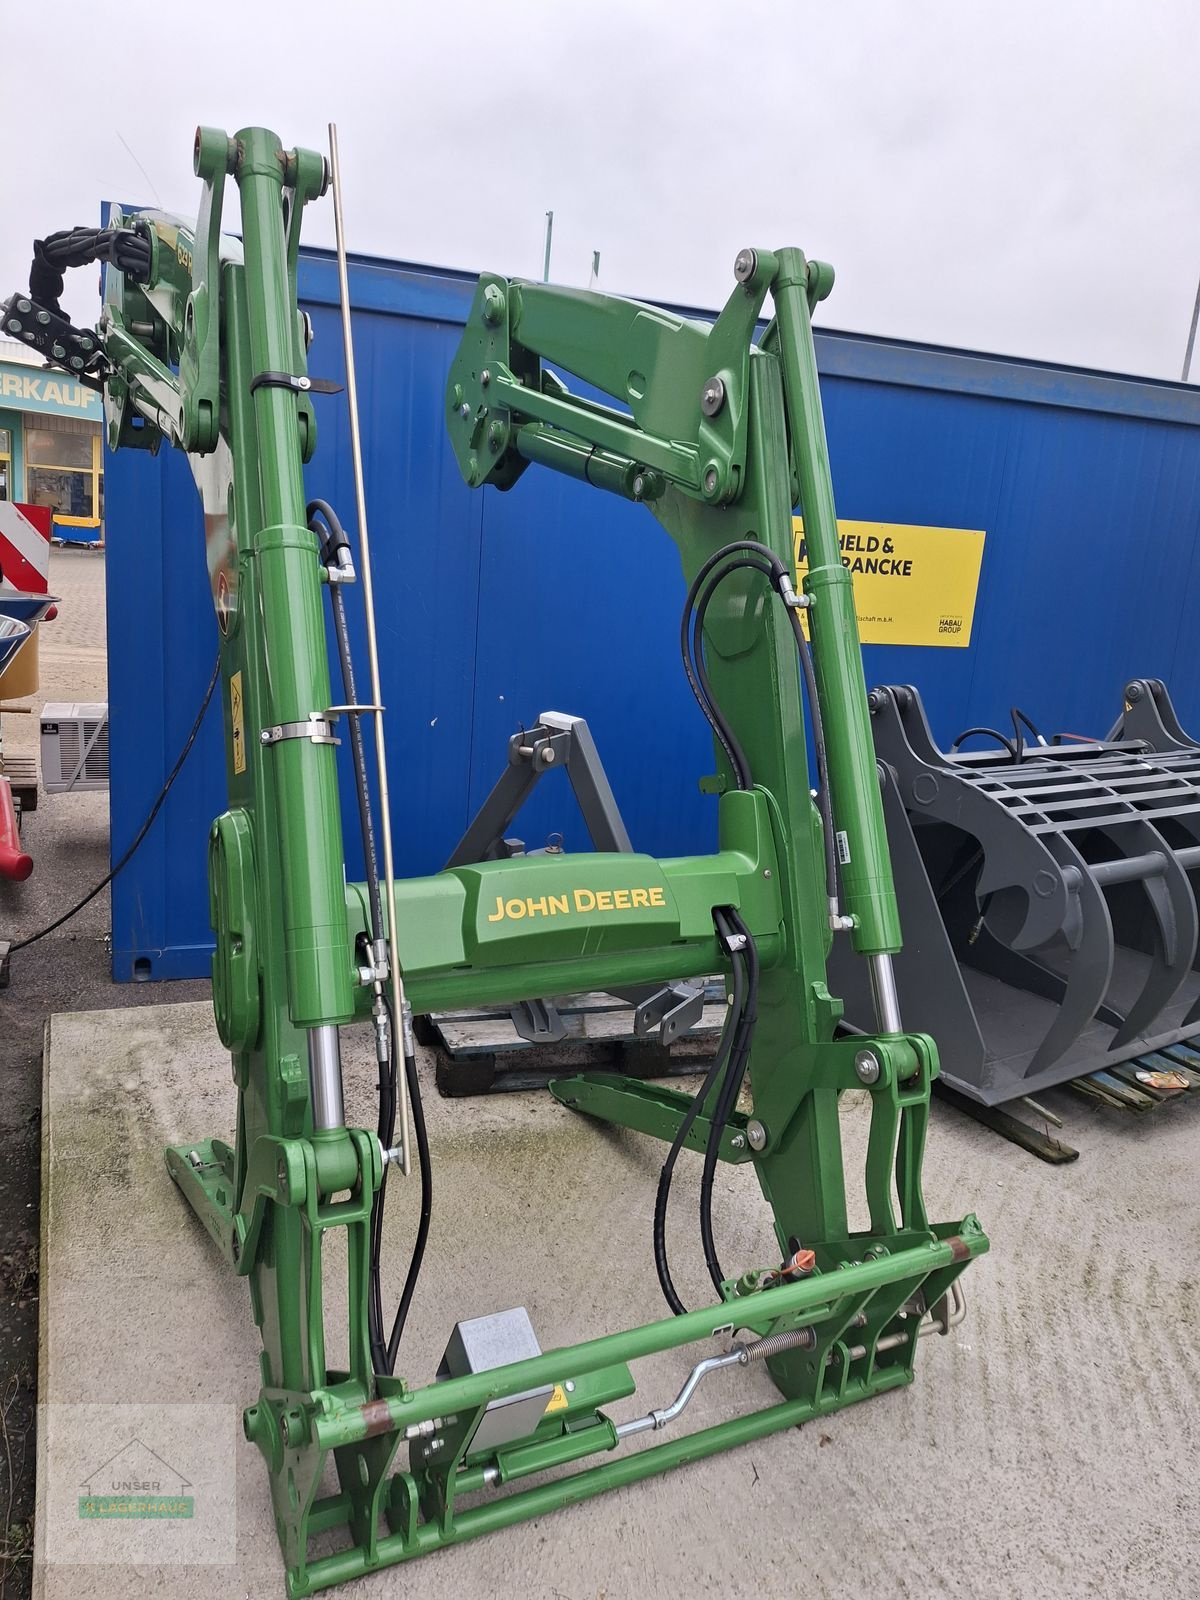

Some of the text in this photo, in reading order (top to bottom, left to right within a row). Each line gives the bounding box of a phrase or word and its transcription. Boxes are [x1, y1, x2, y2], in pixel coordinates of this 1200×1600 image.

[0, 373, 96, 408] RKAUF
[882, 537, 894, 554] &
[938, 626, 961, 634] GROUP
[939, 619, 962, 627] HABAU
[488, 887, 666, 922] JOHN DEERE
